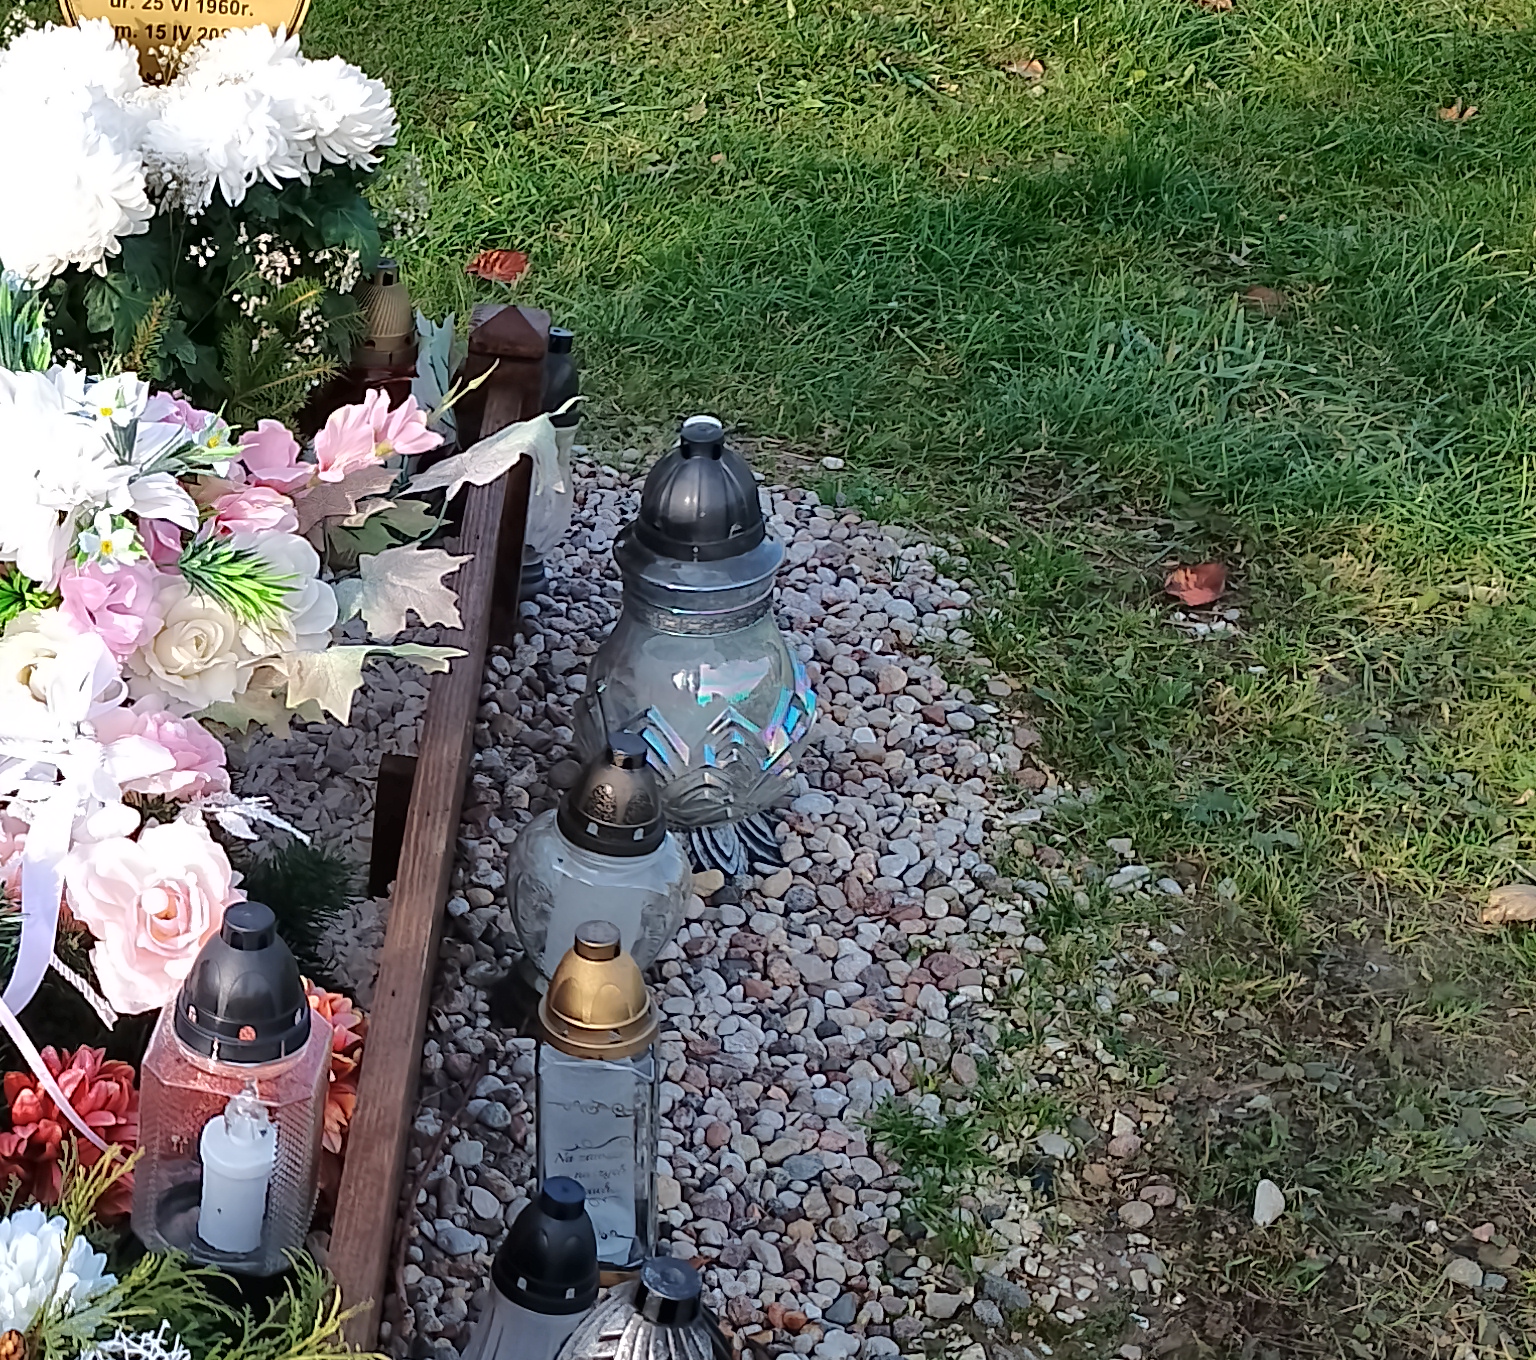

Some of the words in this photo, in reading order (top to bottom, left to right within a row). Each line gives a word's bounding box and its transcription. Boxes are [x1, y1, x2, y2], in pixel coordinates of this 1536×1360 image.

[114, 24, 137, 39] m.
[145, 24, 166, 40] 15
[172, 24, 192, 41] IV
